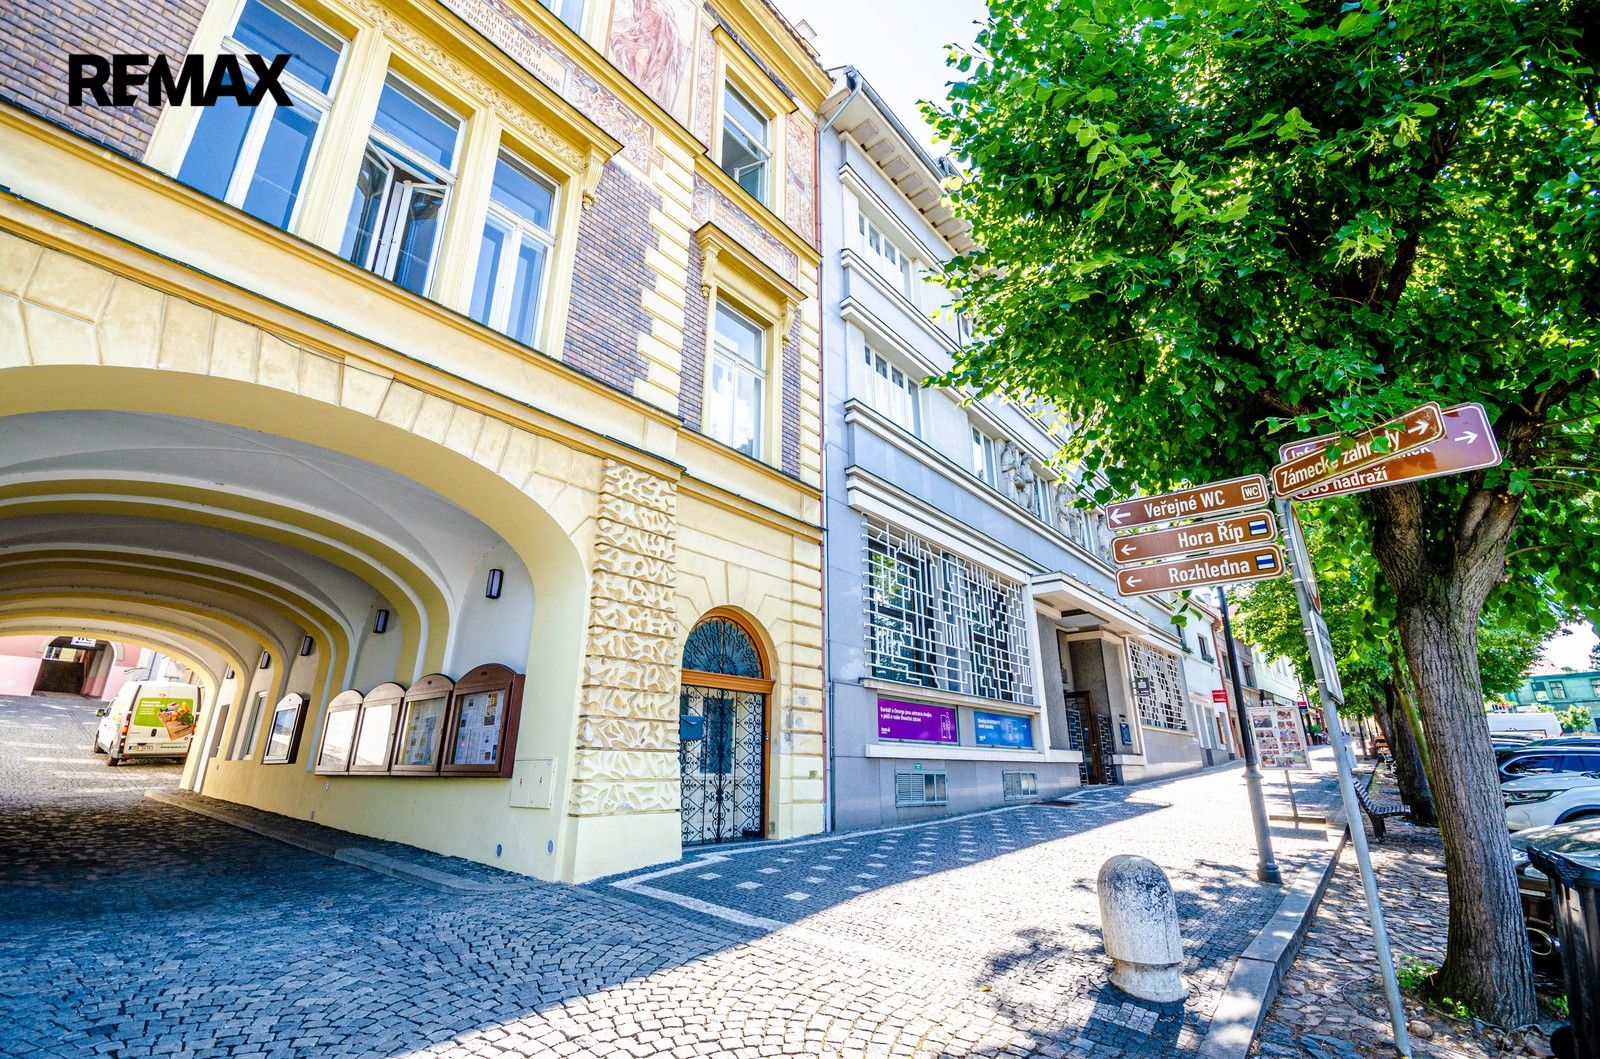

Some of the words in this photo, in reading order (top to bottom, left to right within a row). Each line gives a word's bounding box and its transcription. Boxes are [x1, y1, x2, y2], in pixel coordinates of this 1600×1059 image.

[1341, 429, 1399, 465] zahry
[1144, 496, 1197, 518] Veřejné
[1200, 490, 1225, 508] WC
[1244, 487, 1259, 497] WC
[1178, 531, 1214, 548] Hora
[1217, 521, 1244, 544] Říp
[1168, 559, 1250, 584] Rozhledna
